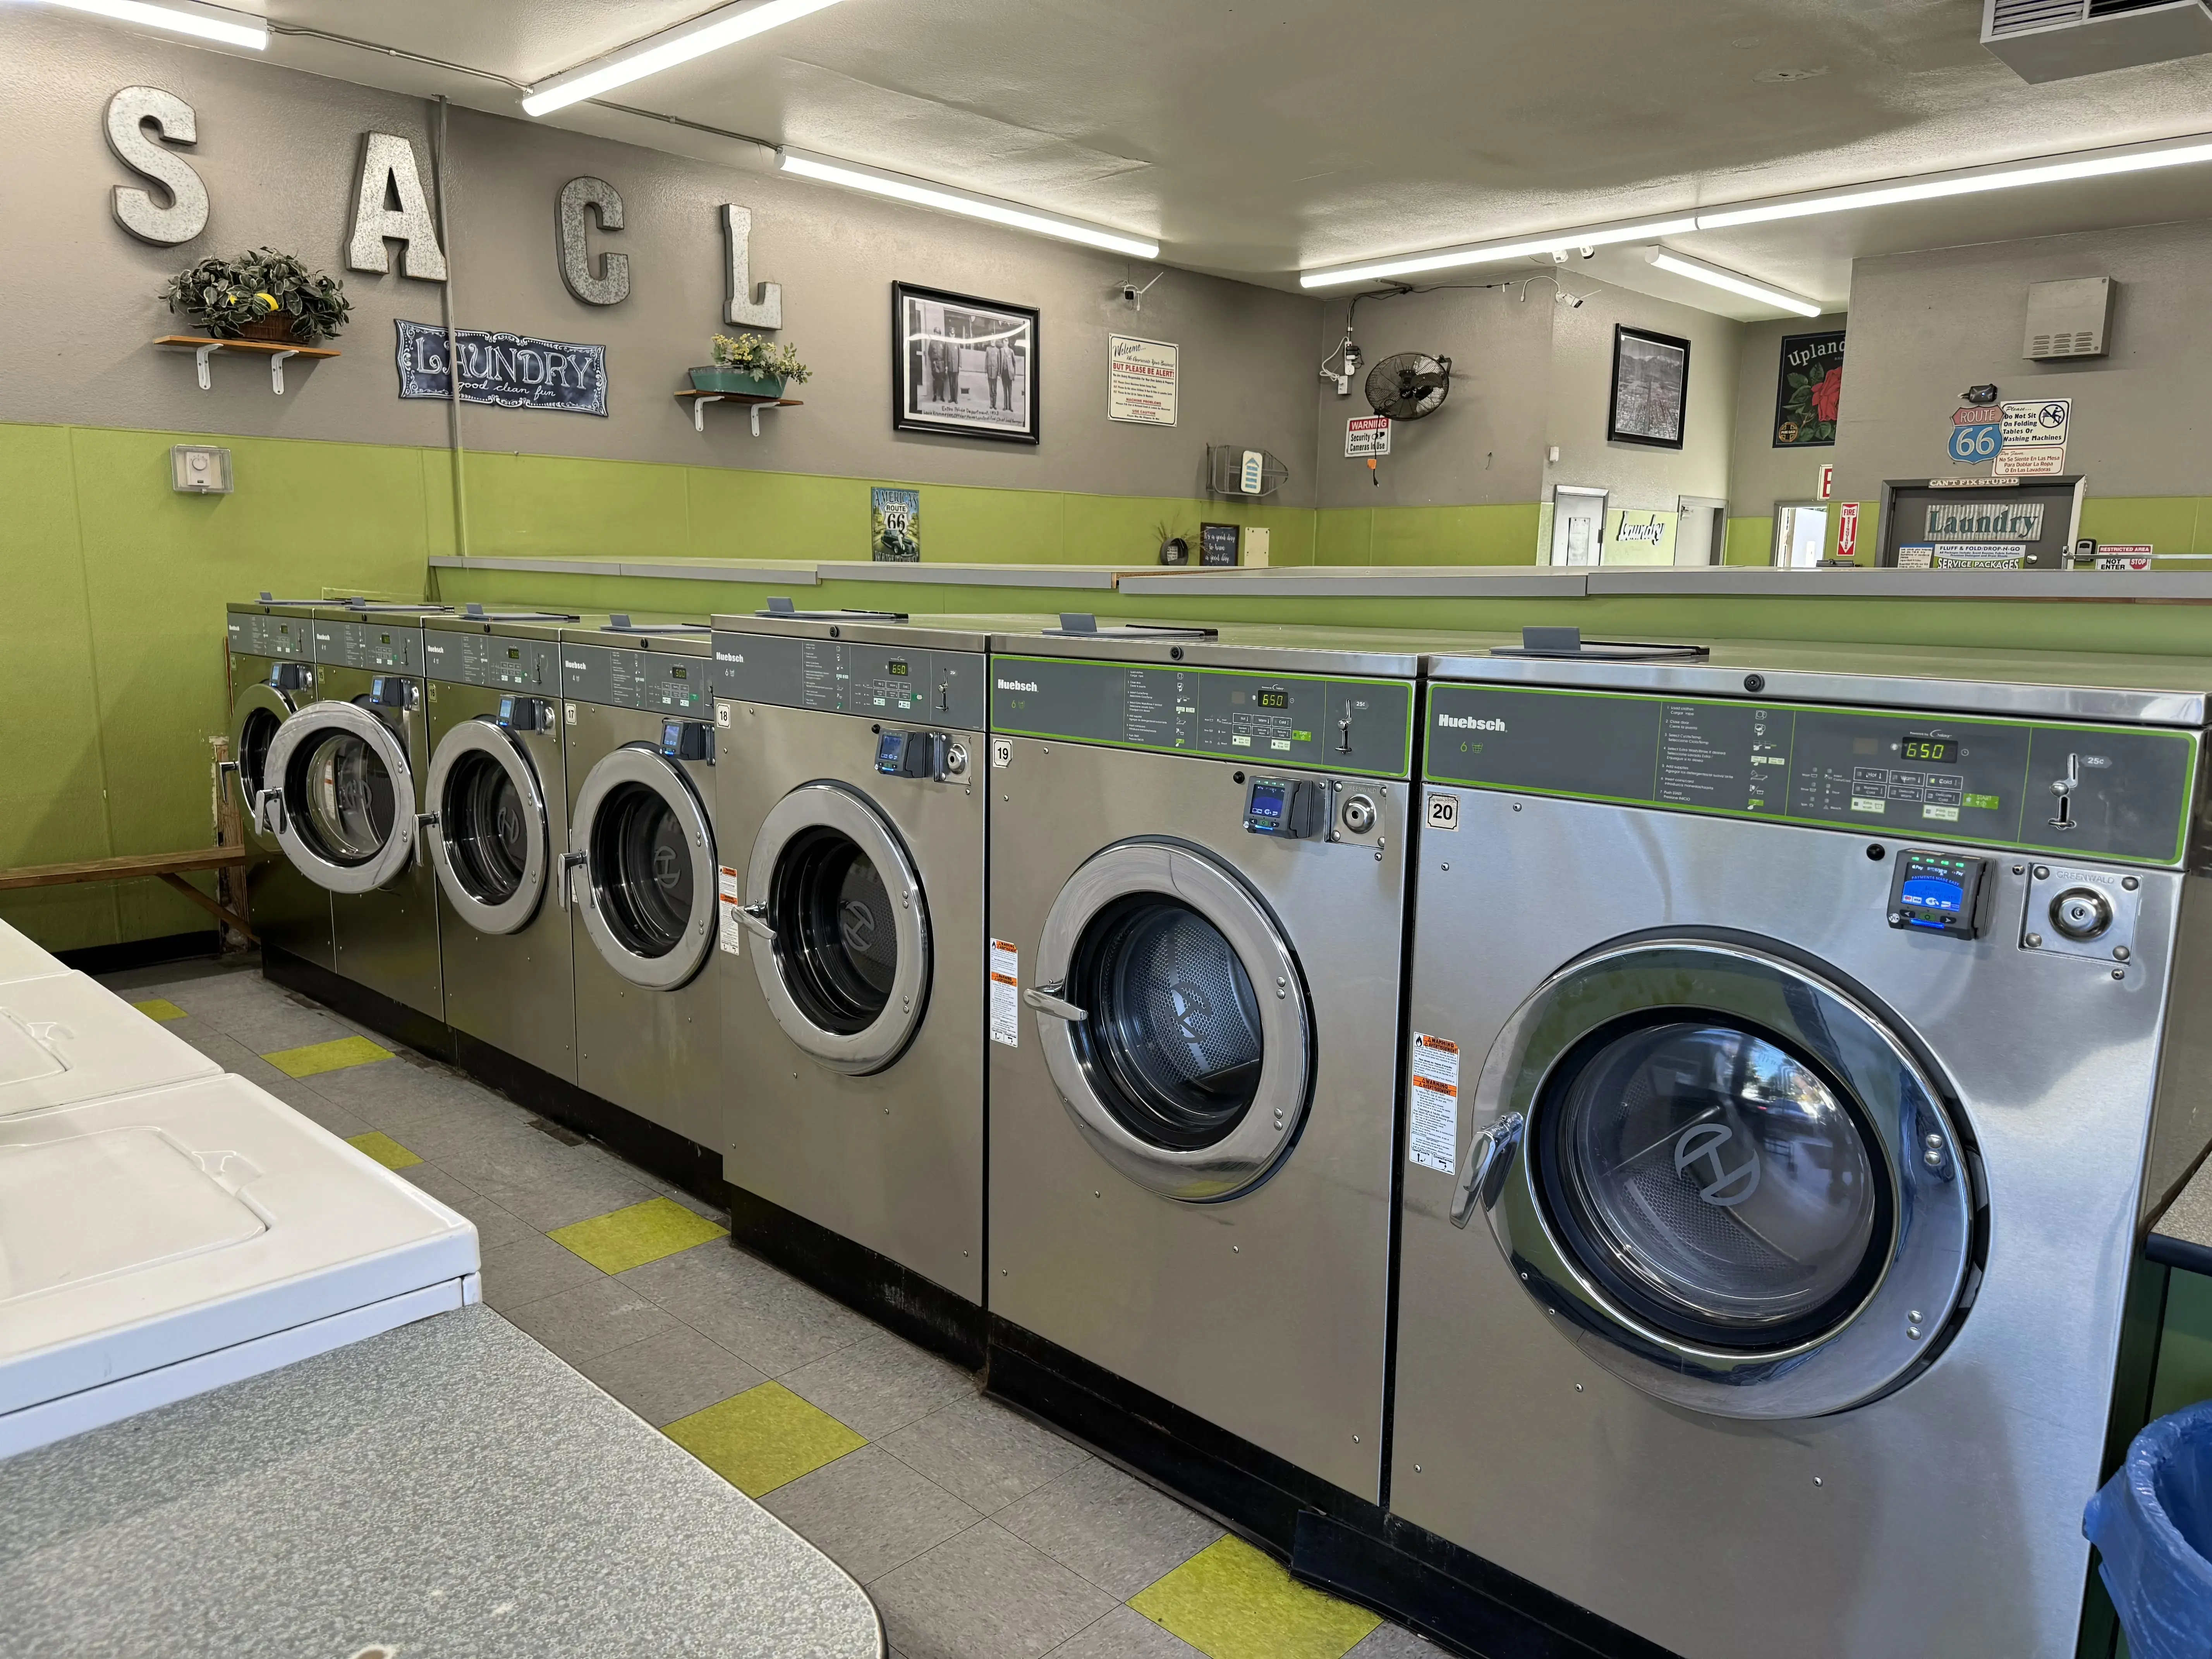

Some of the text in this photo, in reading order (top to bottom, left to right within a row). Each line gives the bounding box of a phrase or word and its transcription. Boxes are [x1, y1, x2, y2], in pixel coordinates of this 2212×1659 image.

[103, 86, 782, 330] S A C L
[416, 337, 593, 390] LAUNDRY
[1125, 364, 1146, 373] PLEASE
[1156, 369, 1174, 378] ALERT!
[458, 381, 556, 400] good clean fun
[1960, 409, 1996, 423] ROUTE
[1352, 419, 1387, 430] WARNING
[1351, 433, 1370, 442] Security
[1956, 427, 1994, 456] 66
[888, 513, 905, 531] 66
[1928, 510, 2040, 538] Laundry
[1937, 558, 2019, 569] SERVICE PACKAGES
[716, 652, 744, 663] Huebsch
[565, 660, 586, 670] Huebsch
[892, 665, 905, 674] 650
[675, 669, 685, 678] 500
[998, 679, 1037, 692] Huebsch
[430, 688, 435, 697] 16
[1262, 694, 1283, 706] 650
[568, 709, 574, 718] 17
[720, 711, 727, 721] 18
[1439, 714, 1505, 732] Huebsch
[1460, 741, 1467, 752] 6
[1906, 743, 1944, 759] 650
[998, 747, 1008, 760] 19
[1345, 785, 1377, 793] GREENWALD
[1433, 803, 1453, 820] 20
[2056, 871, 2114, 884] GREENWALD
[1432, 1038, 1454, 1048] WARNING
[1426, 1079, 1448, 1089] WARNING
